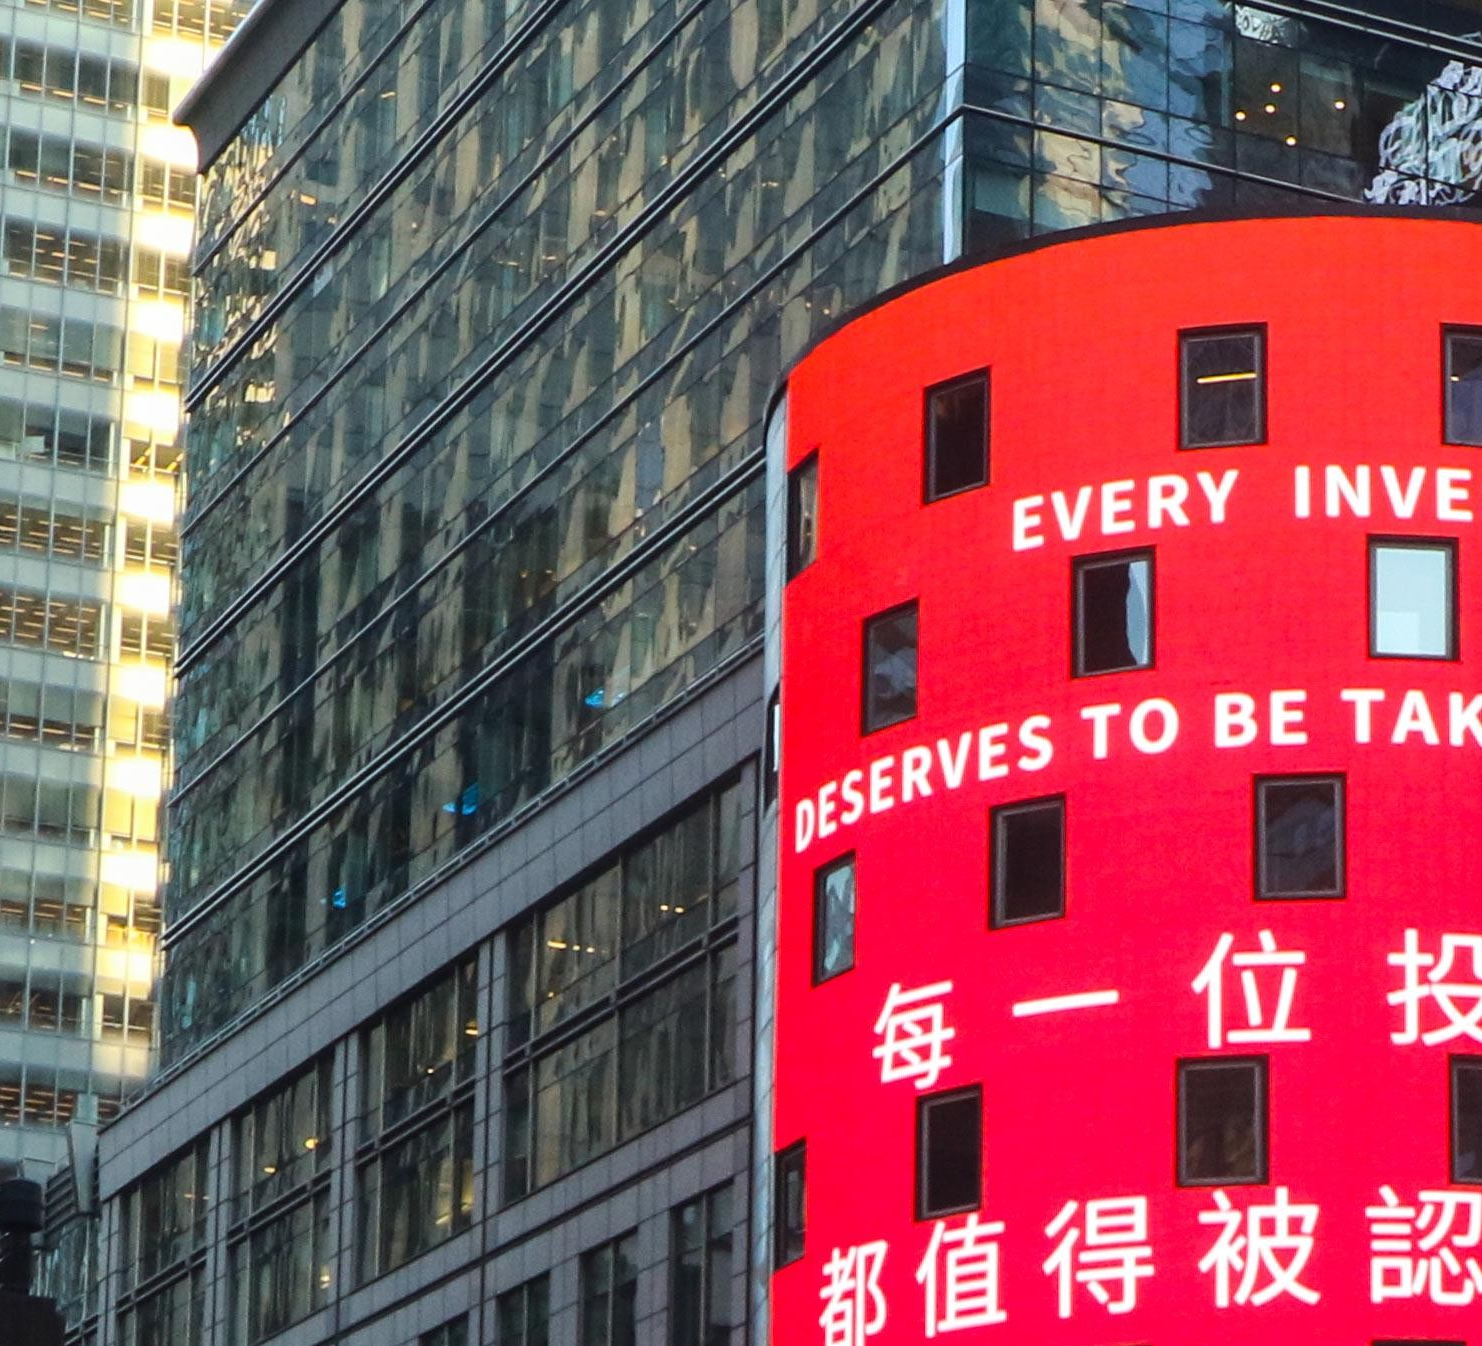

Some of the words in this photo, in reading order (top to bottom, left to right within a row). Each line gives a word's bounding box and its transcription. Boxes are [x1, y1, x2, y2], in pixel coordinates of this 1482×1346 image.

[1013, 469, 1239, 551] EVERY
[795, 715, 1054, 853] DESERVES
[1080, 697, 1180, 758] TO
[1214, 689, 1308, 748] BE
